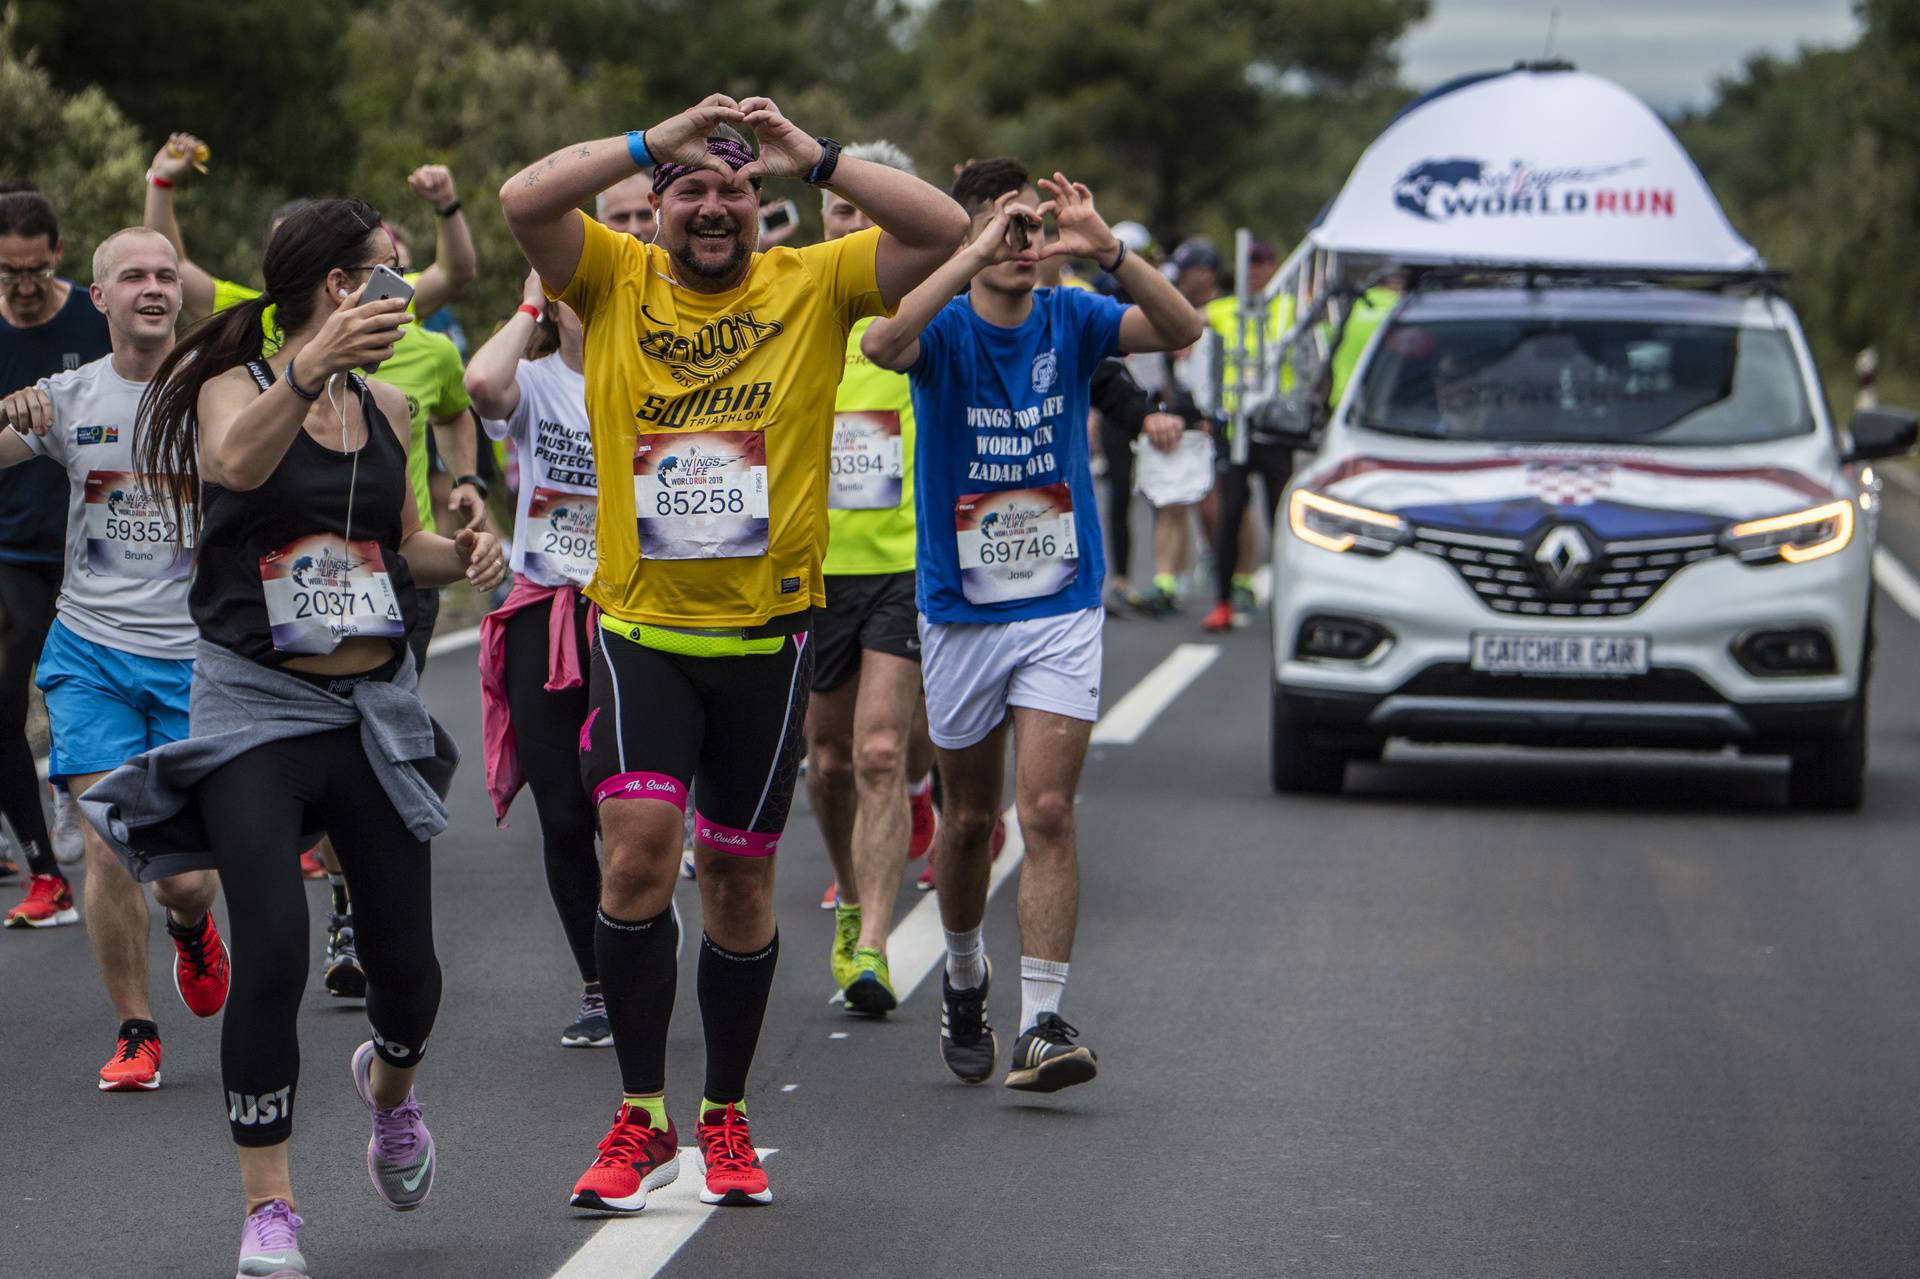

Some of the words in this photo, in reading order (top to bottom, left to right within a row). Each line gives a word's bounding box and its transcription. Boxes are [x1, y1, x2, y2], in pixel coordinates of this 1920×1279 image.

[689, 410, 765, 428] TRIATHLON
[966, 406, 1012, 429] WINGS
[1042, 395, 1065, 418] IFE
[538, 419, 593, 444] INFLUEN
[976, 434, 1033, 456] WORLD
[1033, 424, 1054, 447] UN
[536, 433, 574, 453] MUST
[576, 444, 594, 457] HA
[534, 446, 594, 470] PERFECT
[680, 456, 721, 468] WINGS
[830, 454, 883, 475] 0394
[967, 461, 1023, 482] ZADAR
[1025, 452, 1056, 478] 019
[582, 474, 597, 487] FO
[685, 467, 710, 476] LIFE
[708, 475, 724, 485] 2019
[656, 488, 745, 517] 85258
[106, 518, 178, 543] 59352
[124, 549, 154, 561] Bruno
[543, 532, 597, 561] 2998
[980, 534, 1057, 566] 69746
[1064, 542, 1075, 558] 4
[1008, 569, 1034, 582] Josip
[293, 590, 376, 619] 20371
[387, 603, 398, 618] 4
[1482, 639, 1584, 663] CATCHER
[1589, 639, 1636, 664] CAR
[228, 1084, 291, 1126] JUST
